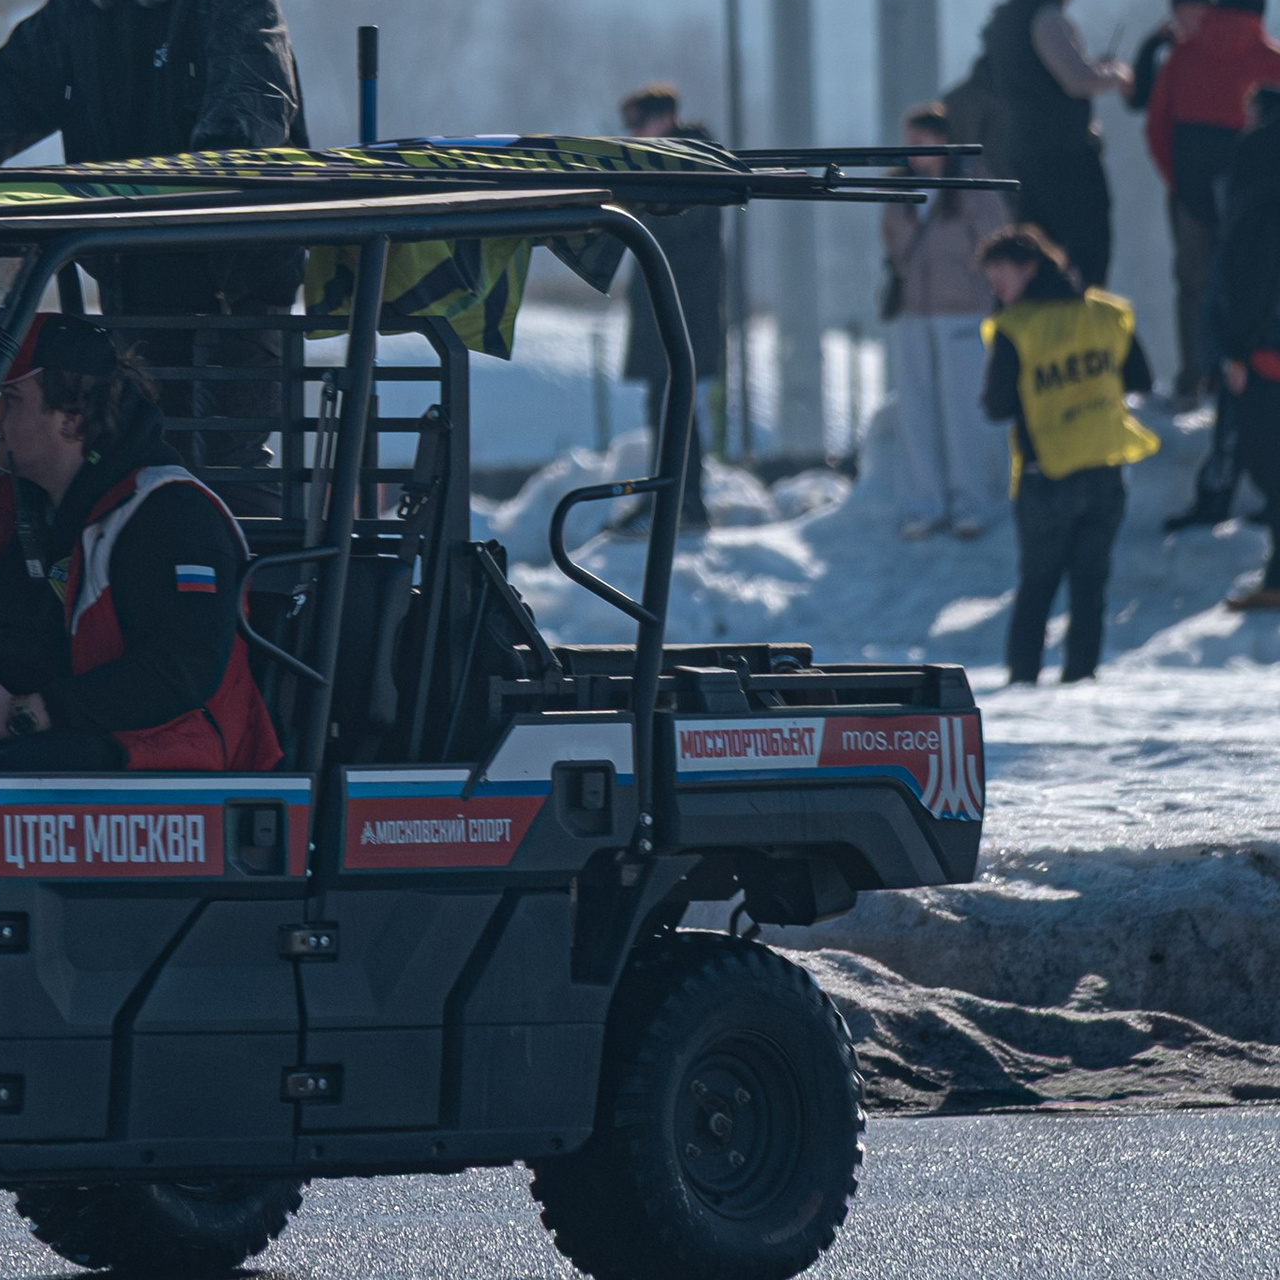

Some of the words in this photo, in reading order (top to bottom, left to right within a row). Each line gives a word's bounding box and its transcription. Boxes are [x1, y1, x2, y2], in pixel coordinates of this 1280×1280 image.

[680, 727, 815, 759] МОССПОРТОБЪЕКТ
[842, 729, 940, 751] mos.race
[3, 814, 77, 869] ЦТВС
[84, 814, 206, 863] МОСКВА
[375, 814, 466, 844] МОСКОВСКИЙ
[468, 818, 512, 843] СПОРТ
